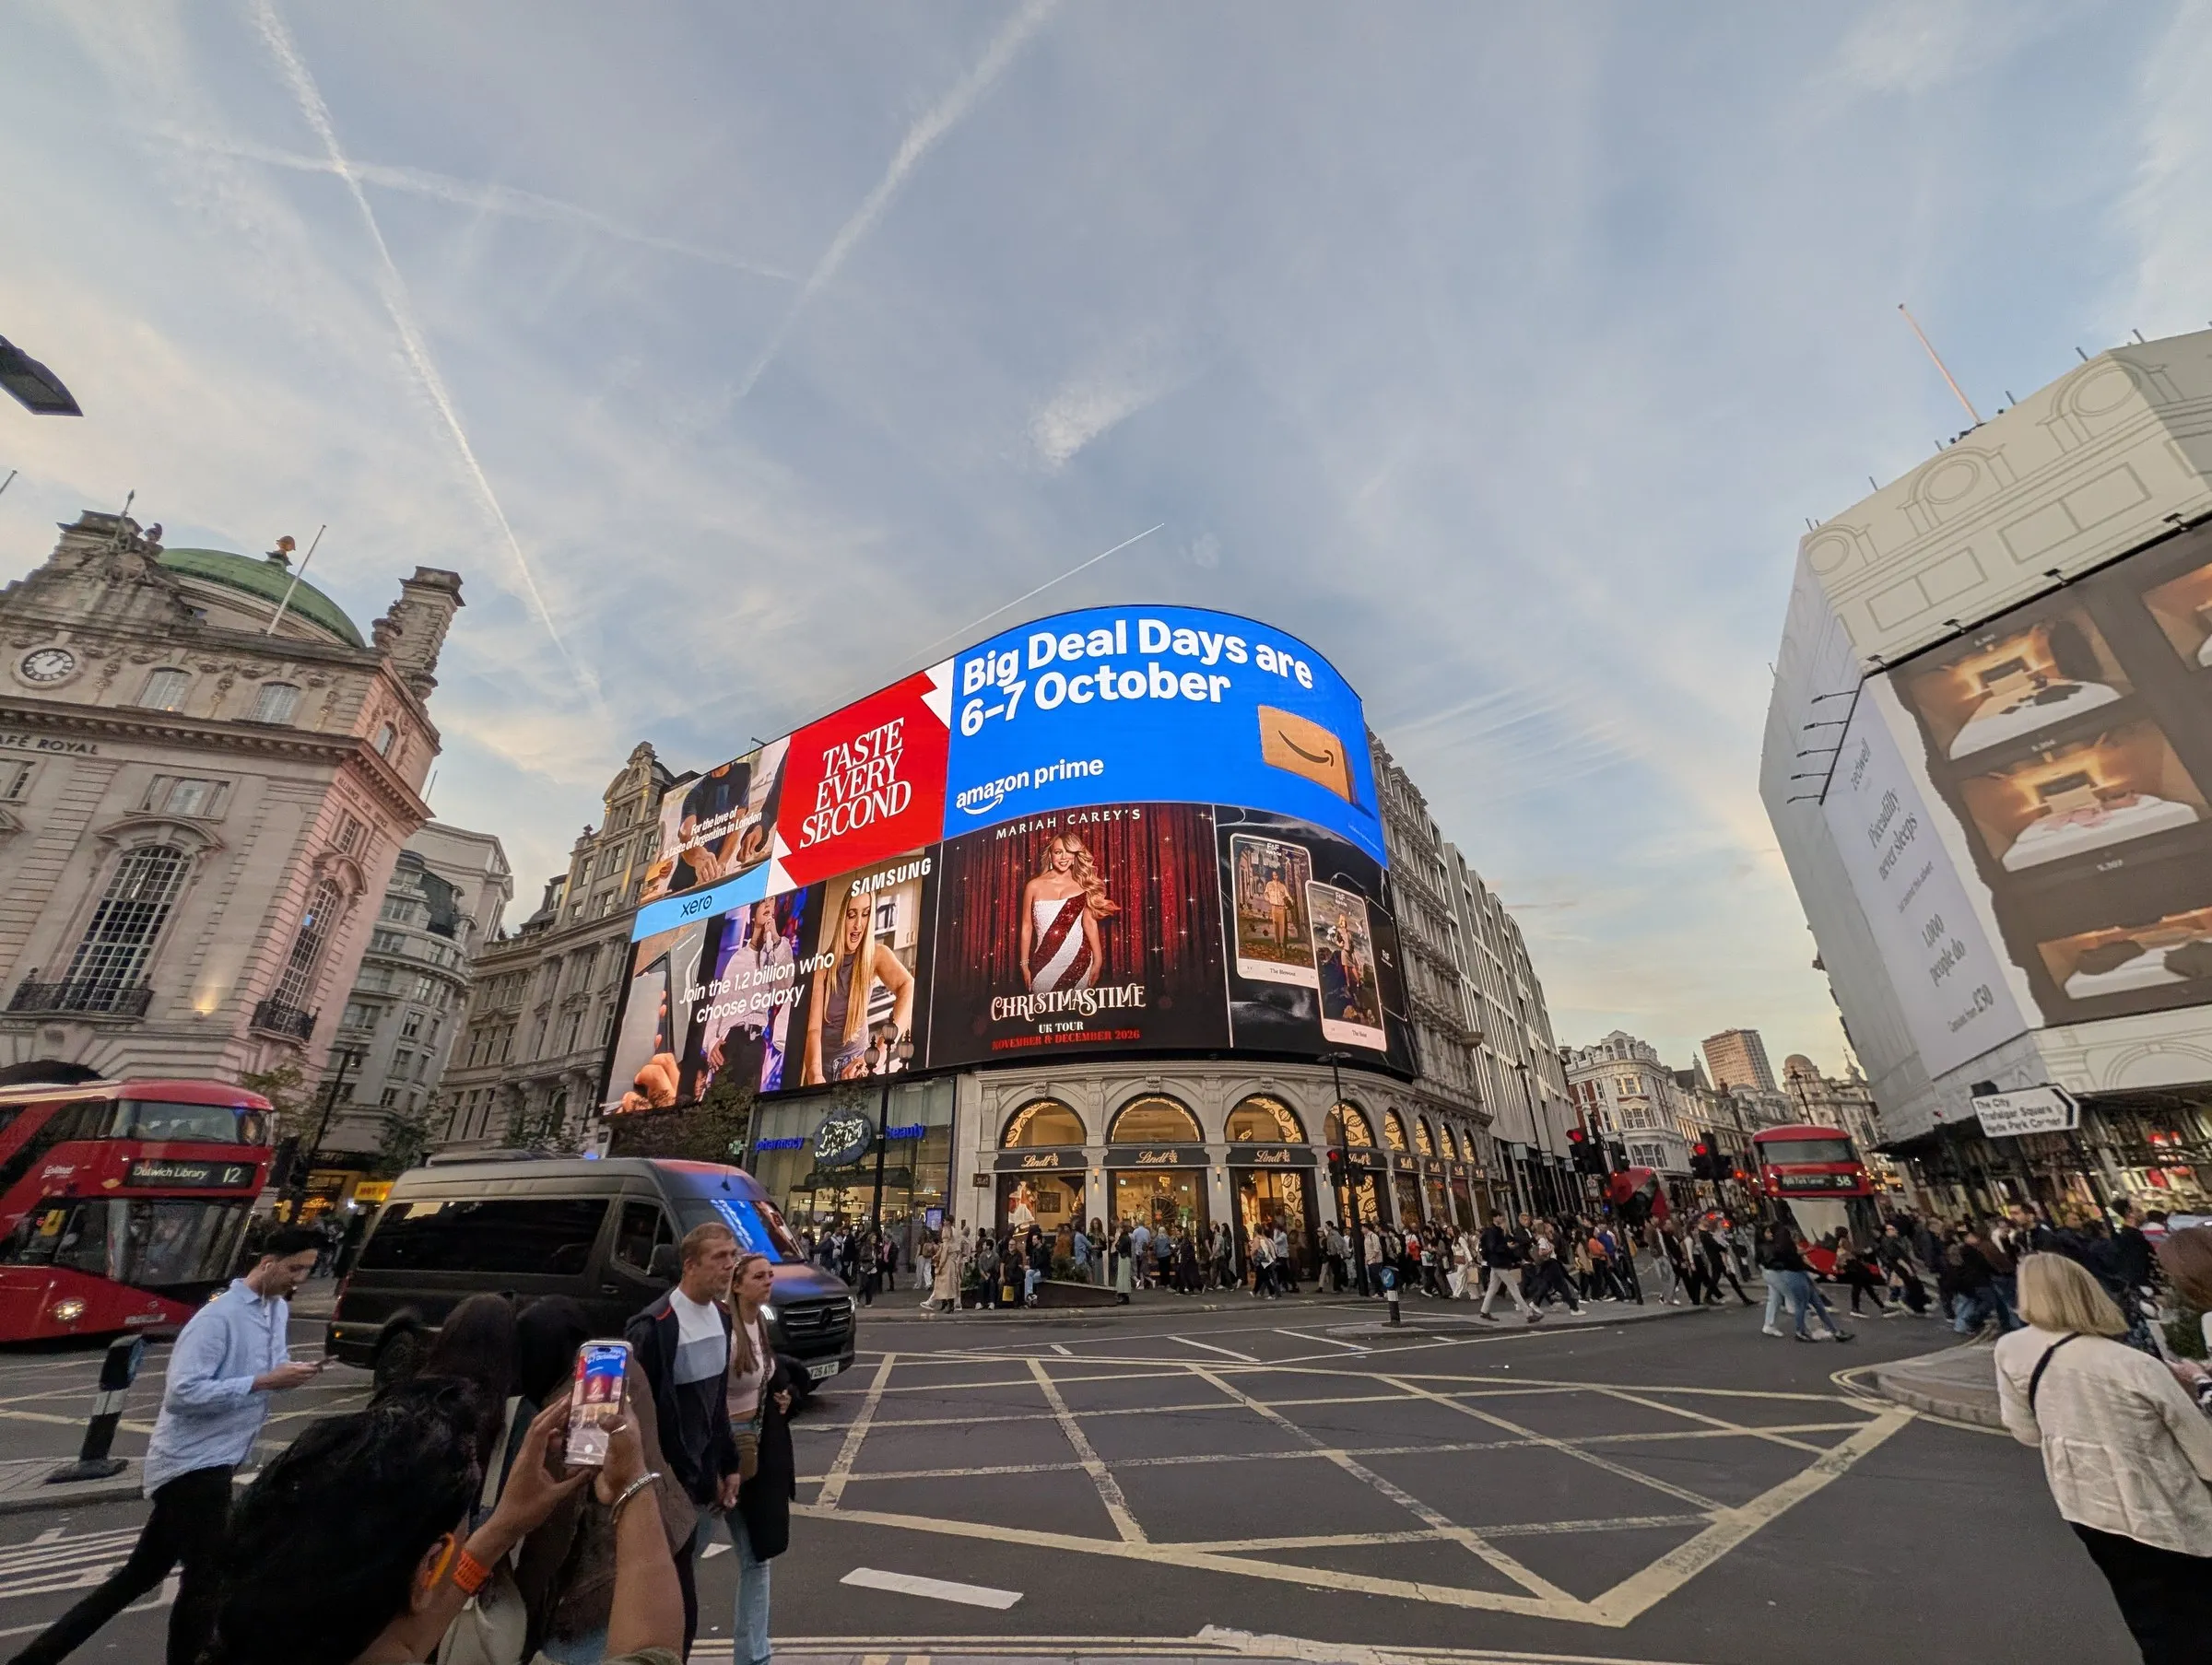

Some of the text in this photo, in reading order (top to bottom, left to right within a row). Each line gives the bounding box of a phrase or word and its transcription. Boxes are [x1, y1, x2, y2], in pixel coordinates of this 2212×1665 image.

[962, 617, 1313, 697] Big Deal Days are
[1033, 661, 1232, 711] October
[36, 738, 99, 756] ROYAL
[822, 717, 905, 780] TASTE
[814, 748, 904, 813] EVERY
[954, 758, 1105, 812] amazon prime
[690, 804, 739, 836] For the love of
[799, 780, 912, 849] SECOND
[995, 808, 1141, 840] MARIAH CAREY'S
[668, 844, 686, 859] taste
[685, 838, 694, 850] of
[693, 824, 726, 847] Argentina
[726, 822, 735, 835] in
[735, 811, 762, 830] London
[850, 857, 933, 897] SAMSUNG
[680, 895, 712, 919] xero
[679, 952, 835, 1006] Join the 1.2 billion who
[696, 982, 806, 1024] choose Galaxy
[990, 983, 1147, 1023] CHRISTMASTIME
[992, 1029, 1141, 1050] NOVEMBER & DECEMBER 2026
[1038, 1021, 1084, 1034] UK TOUR
[1975, 1097, 2010, 1108] The City
[1981, 1106, 2053, 1121] Trafalgar Square
[2030, 1118, 2061, 1129] Corner
[756, 1135, 805, 1152] pharmacy
[1135, 1151, 1170, 1164] Lindt
[1254, 1150, 1283, 1164] Lindt
[132, 1167, 242, 1184] Dulwich Library 12
[1021, 1155, 1052, 1168] Lindt
[1835, 1175, 1853, 1188] 38
